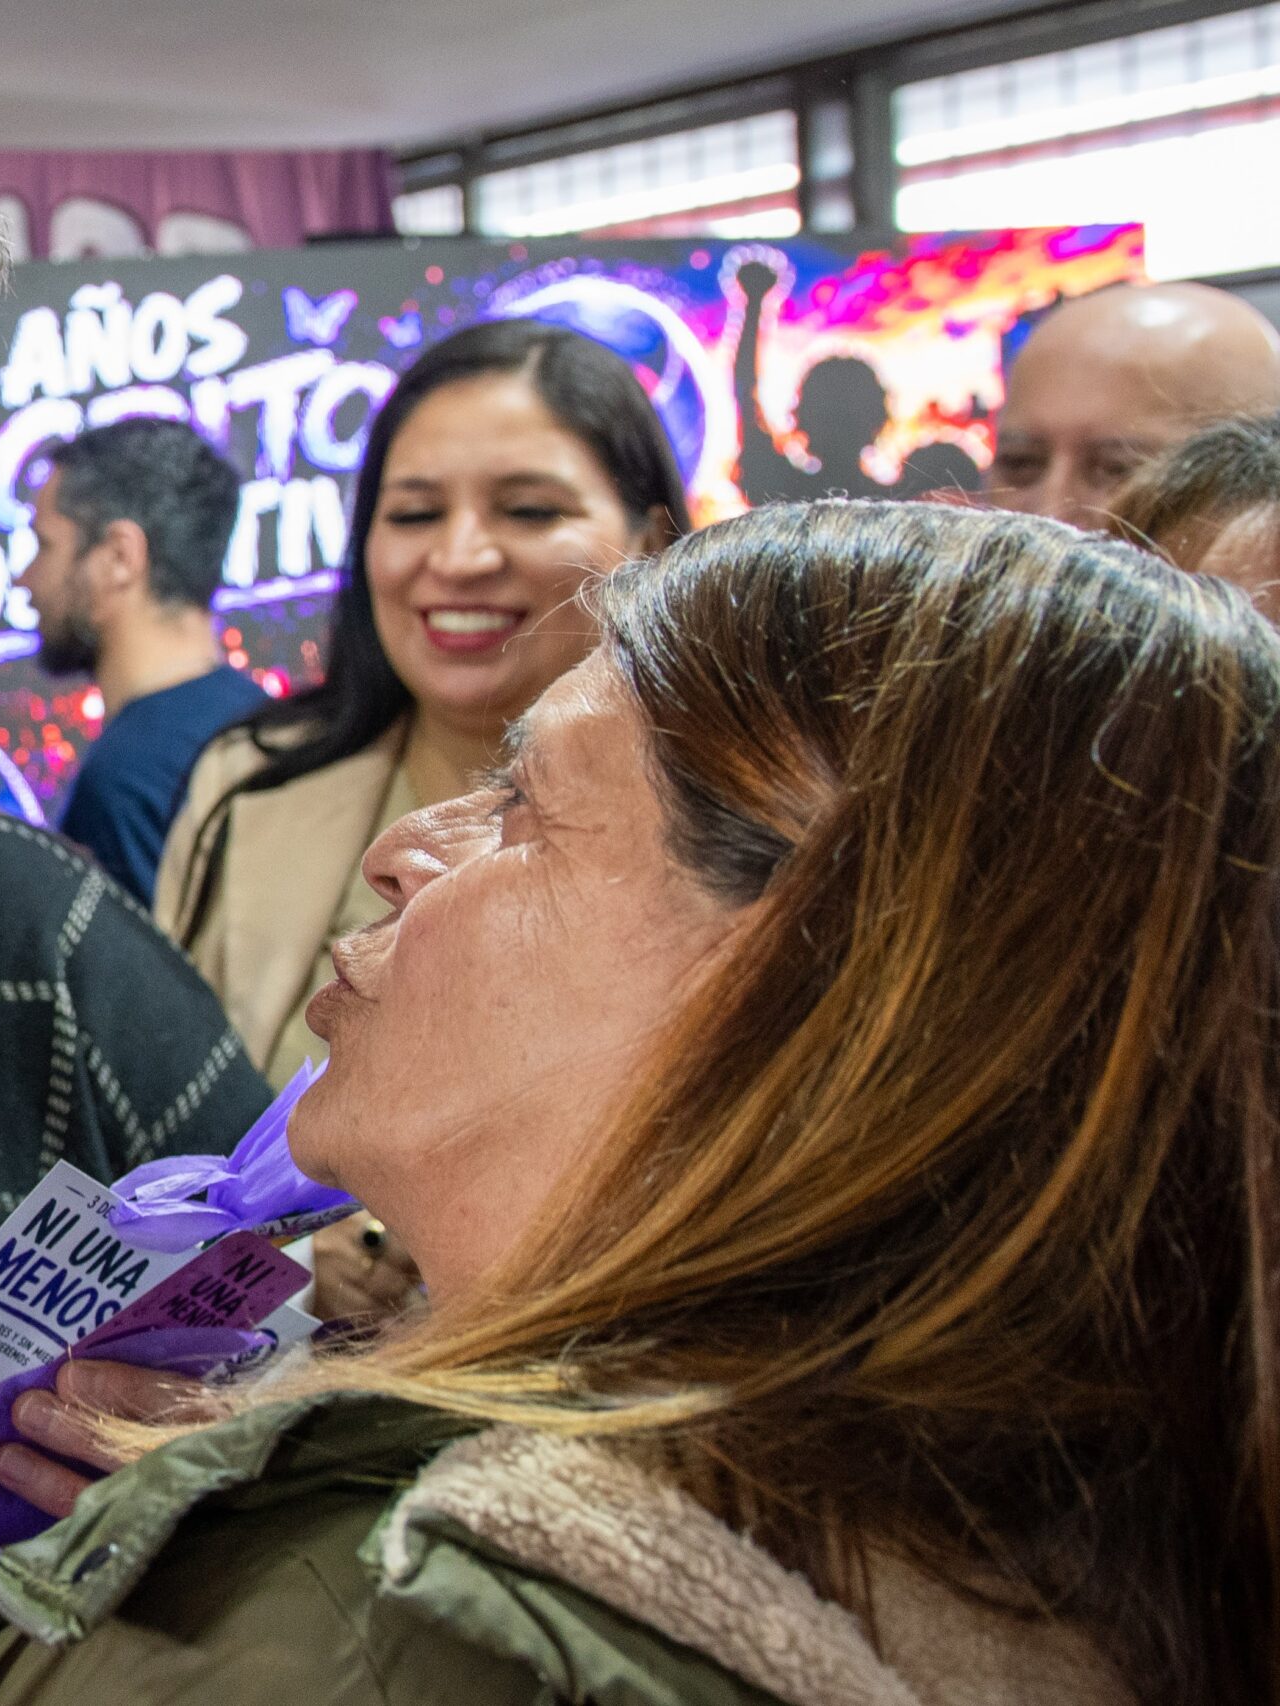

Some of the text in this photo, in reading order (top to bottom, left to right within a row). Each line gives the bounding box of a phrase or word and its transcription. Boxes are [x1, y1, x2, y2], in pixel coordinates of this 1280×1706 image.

[1, 274, 249, 407] AÑOS
[87, 1195, 116, 1219] 3 DE
[22, 1198, 149, 1298] NI UNA
[223, 1253, 276, 1290] NI
[190, 1274, 248, 1318] UNA
[11, 1331, 20, 1341] Y
[17, 1335, 34, 1351] SIN
